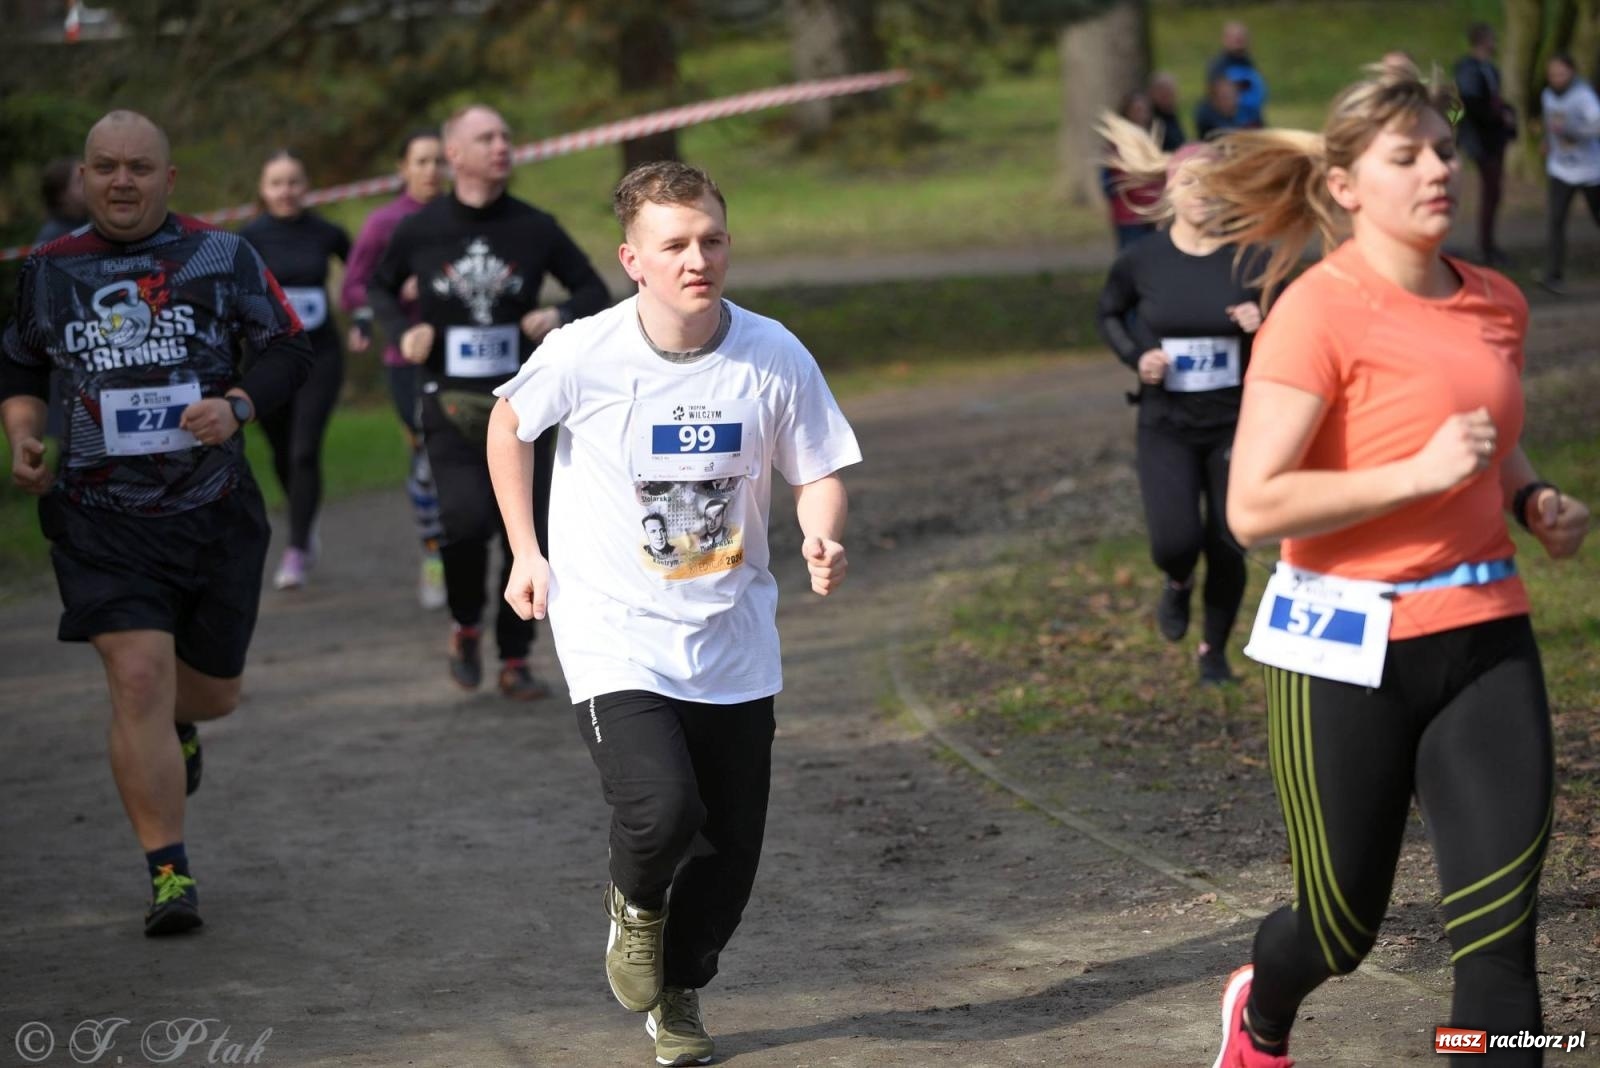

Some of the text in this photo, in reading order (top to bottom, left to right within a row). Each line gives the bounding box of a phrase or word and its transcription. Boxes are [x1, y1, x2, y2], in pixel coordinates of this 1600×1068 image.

[80, 337, 188, 372] TRENING
[138, 408, 168, 431] 27
[688, 410, 722, 419] WILCZYM
[678, 425, 716, 452] 99
[1287, 599, 1337, 639] 57
